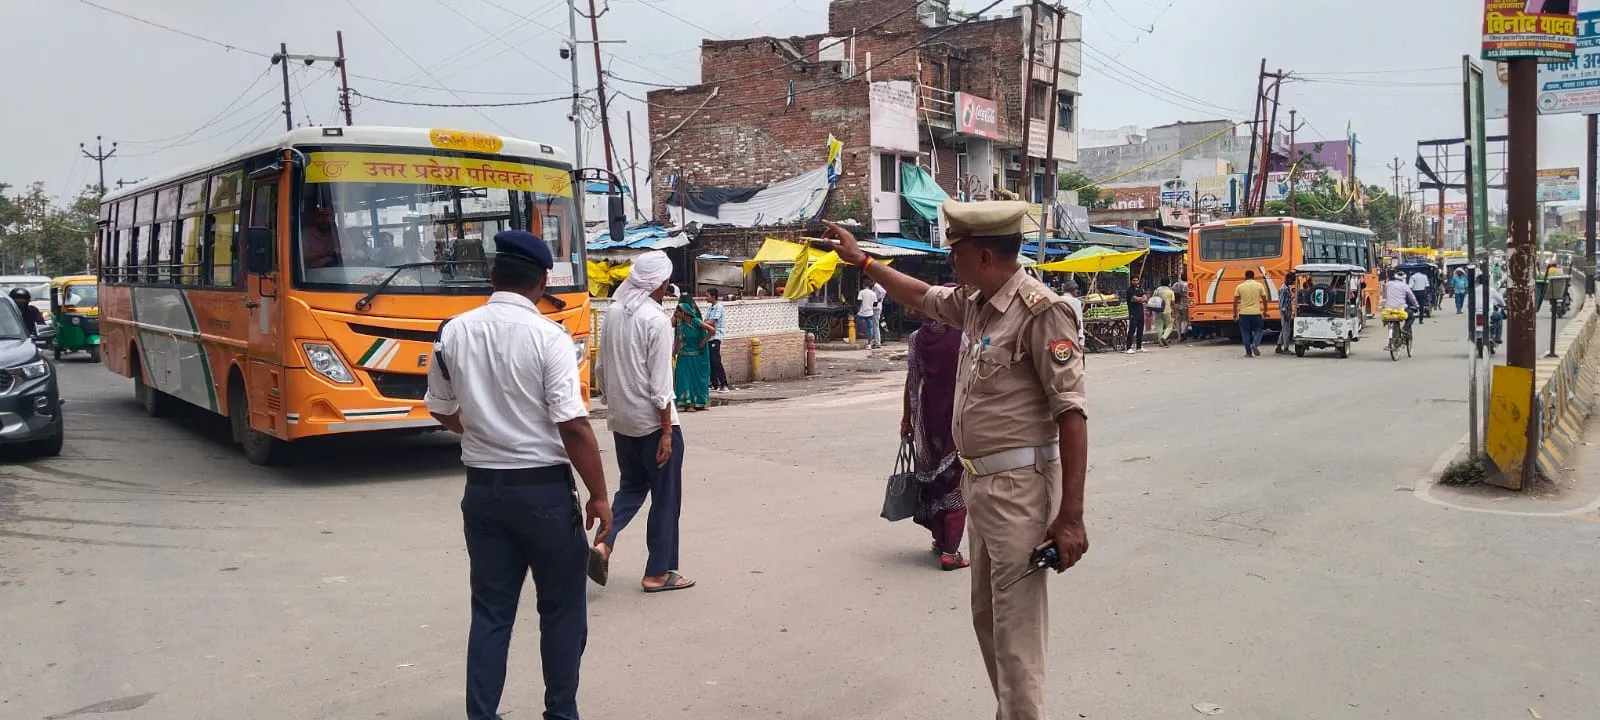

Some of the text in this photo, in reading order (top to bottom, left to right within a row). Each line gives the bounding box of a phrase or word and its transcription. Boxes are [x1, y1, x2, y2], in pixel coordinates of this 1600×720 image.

[1486, 11, 1538, 34] विनोद
[1540, 16, 1575, 36] यादव
[363, 159, 534, 187] उत्तर प्रदेश परिवहन
